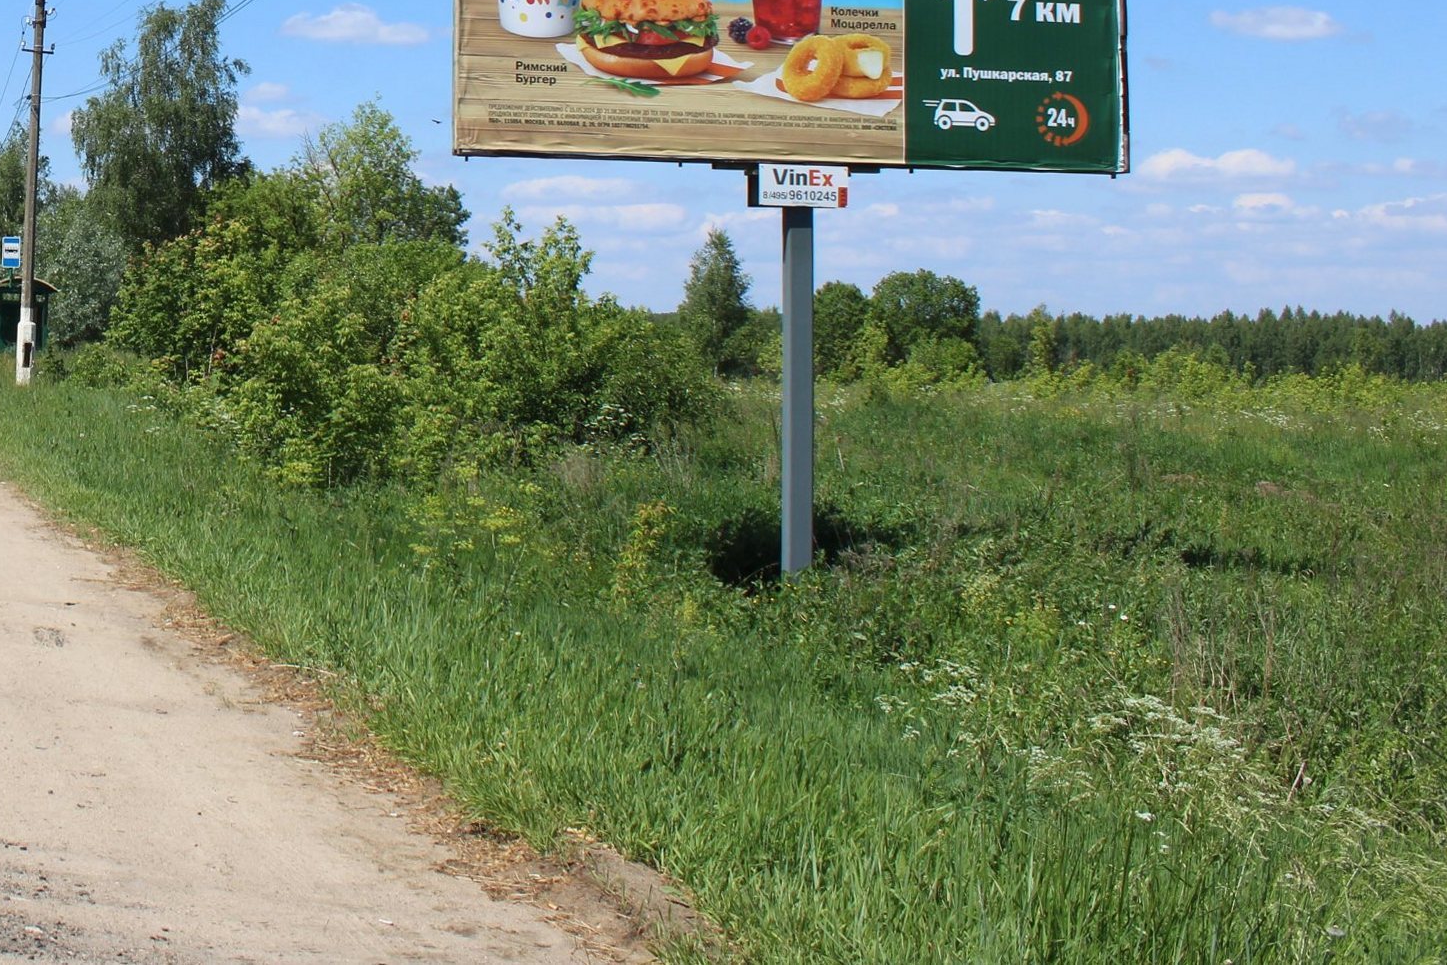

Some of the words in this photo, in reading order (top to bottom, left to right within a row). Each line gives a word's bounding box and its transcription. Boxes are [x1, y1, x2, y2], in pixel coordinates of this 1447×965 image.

[830, 6, 879, 17] Колечки
[830, 18, 897, 31] Моцарелла
[515, 60, 568, 72] Римский
[515, 73, 557, 86] Бургер
[940, 67, 960, 79] ул.
[963, 66, 1053, 83] Пушкарская,
[1055, 70, 1073, 82] 87
[773, 168, 833, 186] VinEx
[788, 190, 837, 201] 9610245
